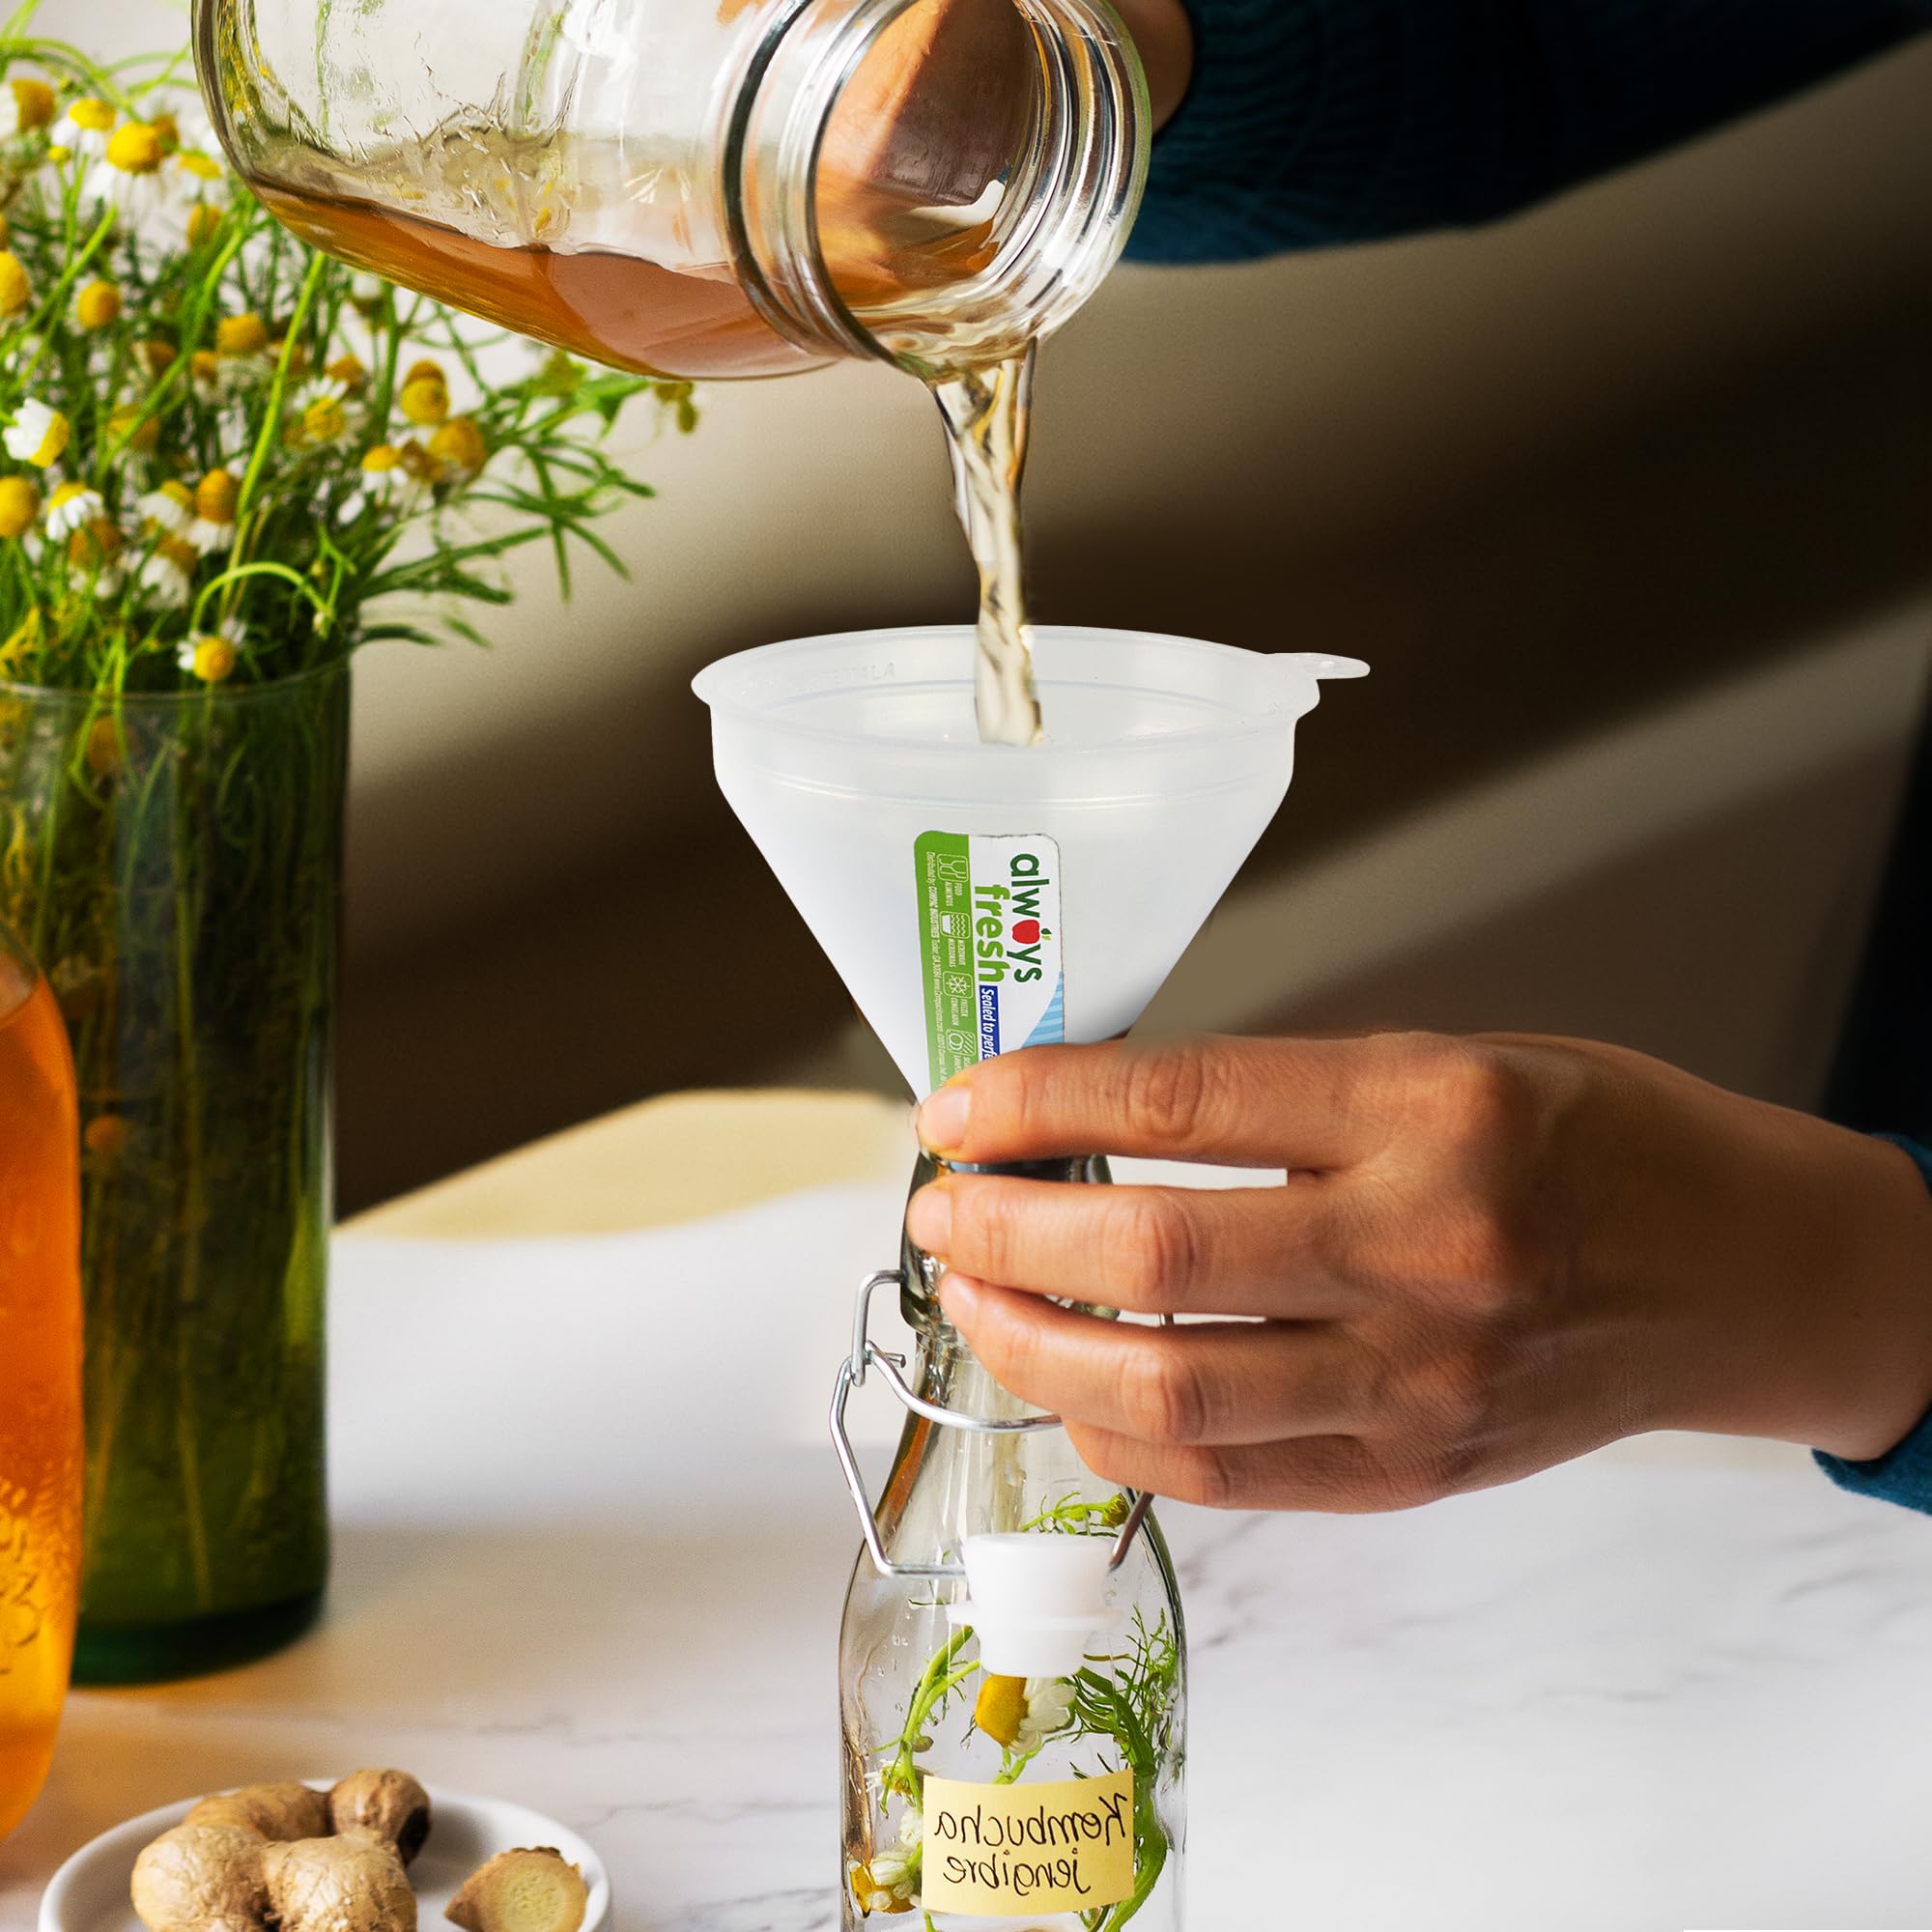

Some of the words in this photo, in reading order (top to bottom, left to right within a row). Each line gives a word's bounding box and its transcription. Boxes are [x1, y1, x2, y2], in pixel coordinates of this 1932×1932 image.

[974, 884, 1011, 982] fresh
[1007, 853, 1051, 982] alwys
[981, 988, 996, 1022] Sealed
[982, 1023, 995, 1033] to
[981, 1034, 997, 1060] perfe
